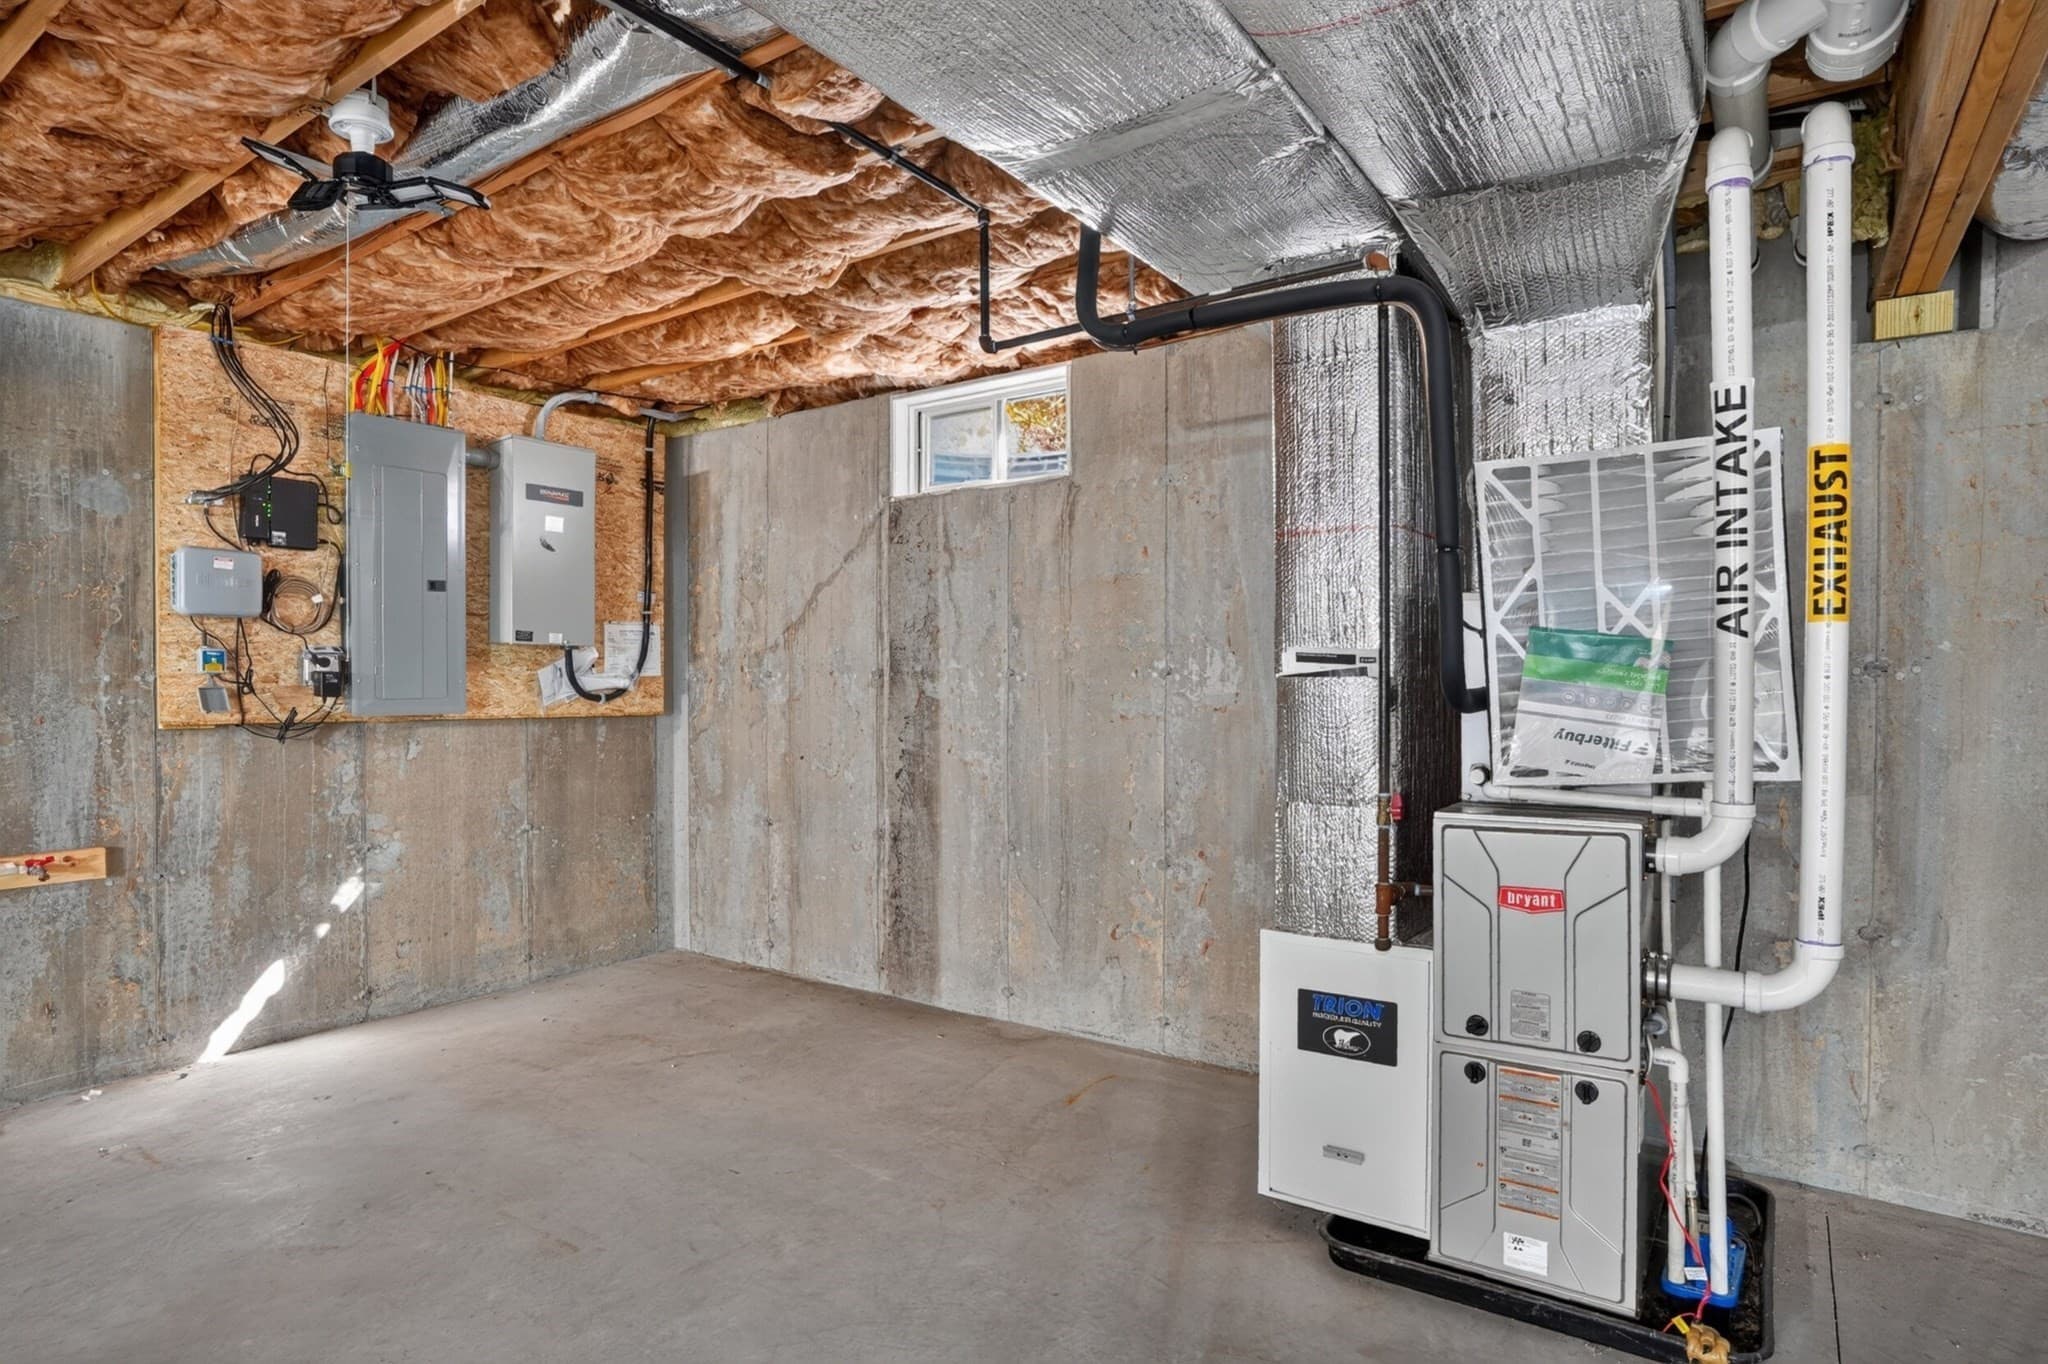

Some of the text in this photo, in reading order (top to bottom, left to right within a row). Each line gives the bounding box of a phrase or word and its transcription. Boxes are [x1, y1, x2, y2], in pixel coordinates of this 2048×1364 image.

[1714, 385, 1749, 639] AIR INTAKE
[1813, 449, 1848, 616] EXHAUST
[1553, 727, 1632, 752] Filterbuy
[1507, 892, 1556, 907] bryant
[1312, 993, 1383, 1020] TRION
